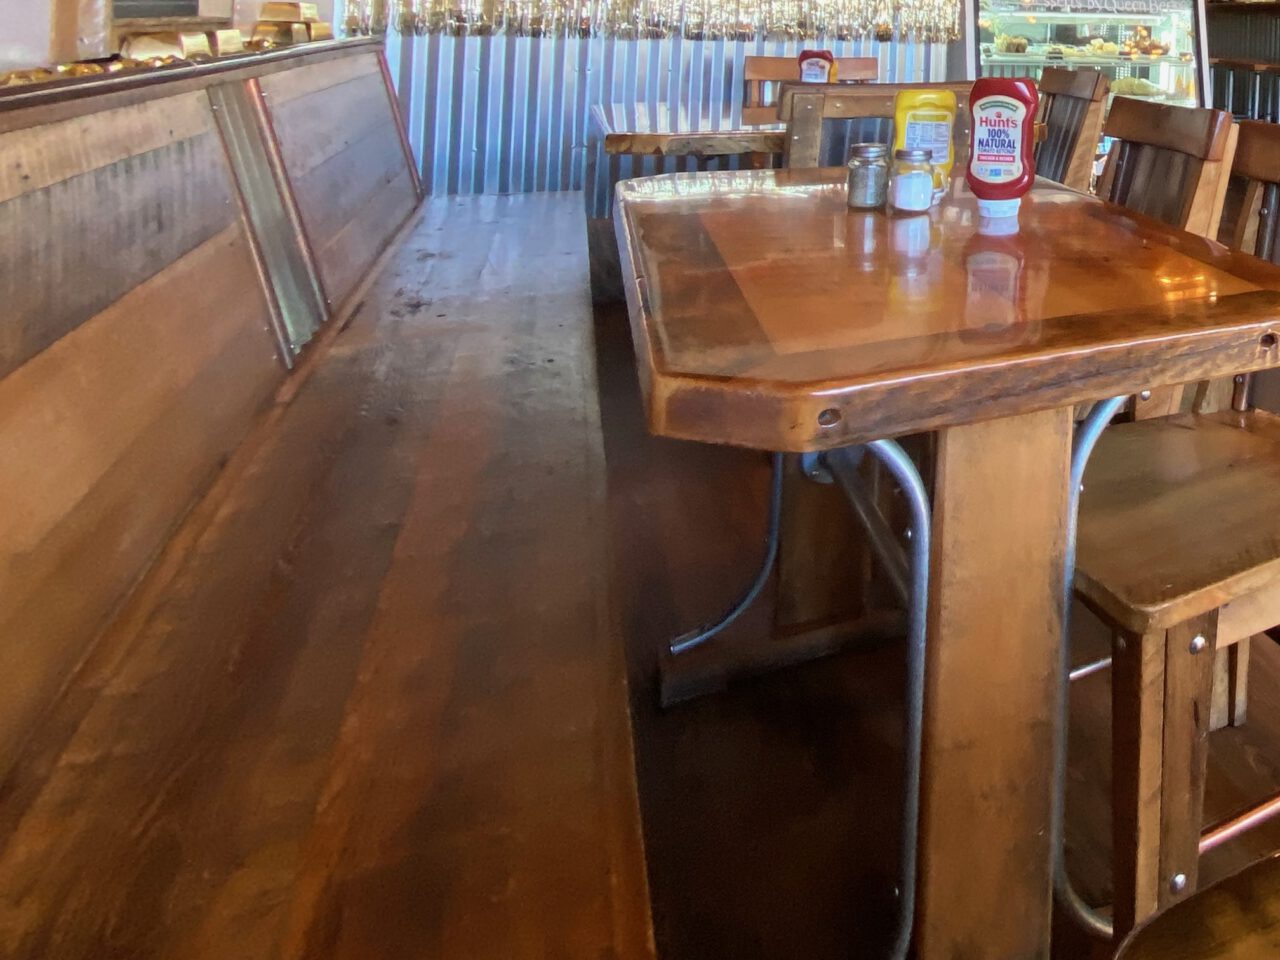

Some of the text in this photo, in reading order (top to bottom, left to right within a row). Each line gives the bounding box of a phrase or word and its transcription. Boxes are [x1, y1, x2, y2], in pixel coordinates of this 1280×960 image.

[979, 117, 1018, 128] Hunt's
[987, 128, 1010, 139] 100%
[978, 138, 1017, 149] NATURAL
